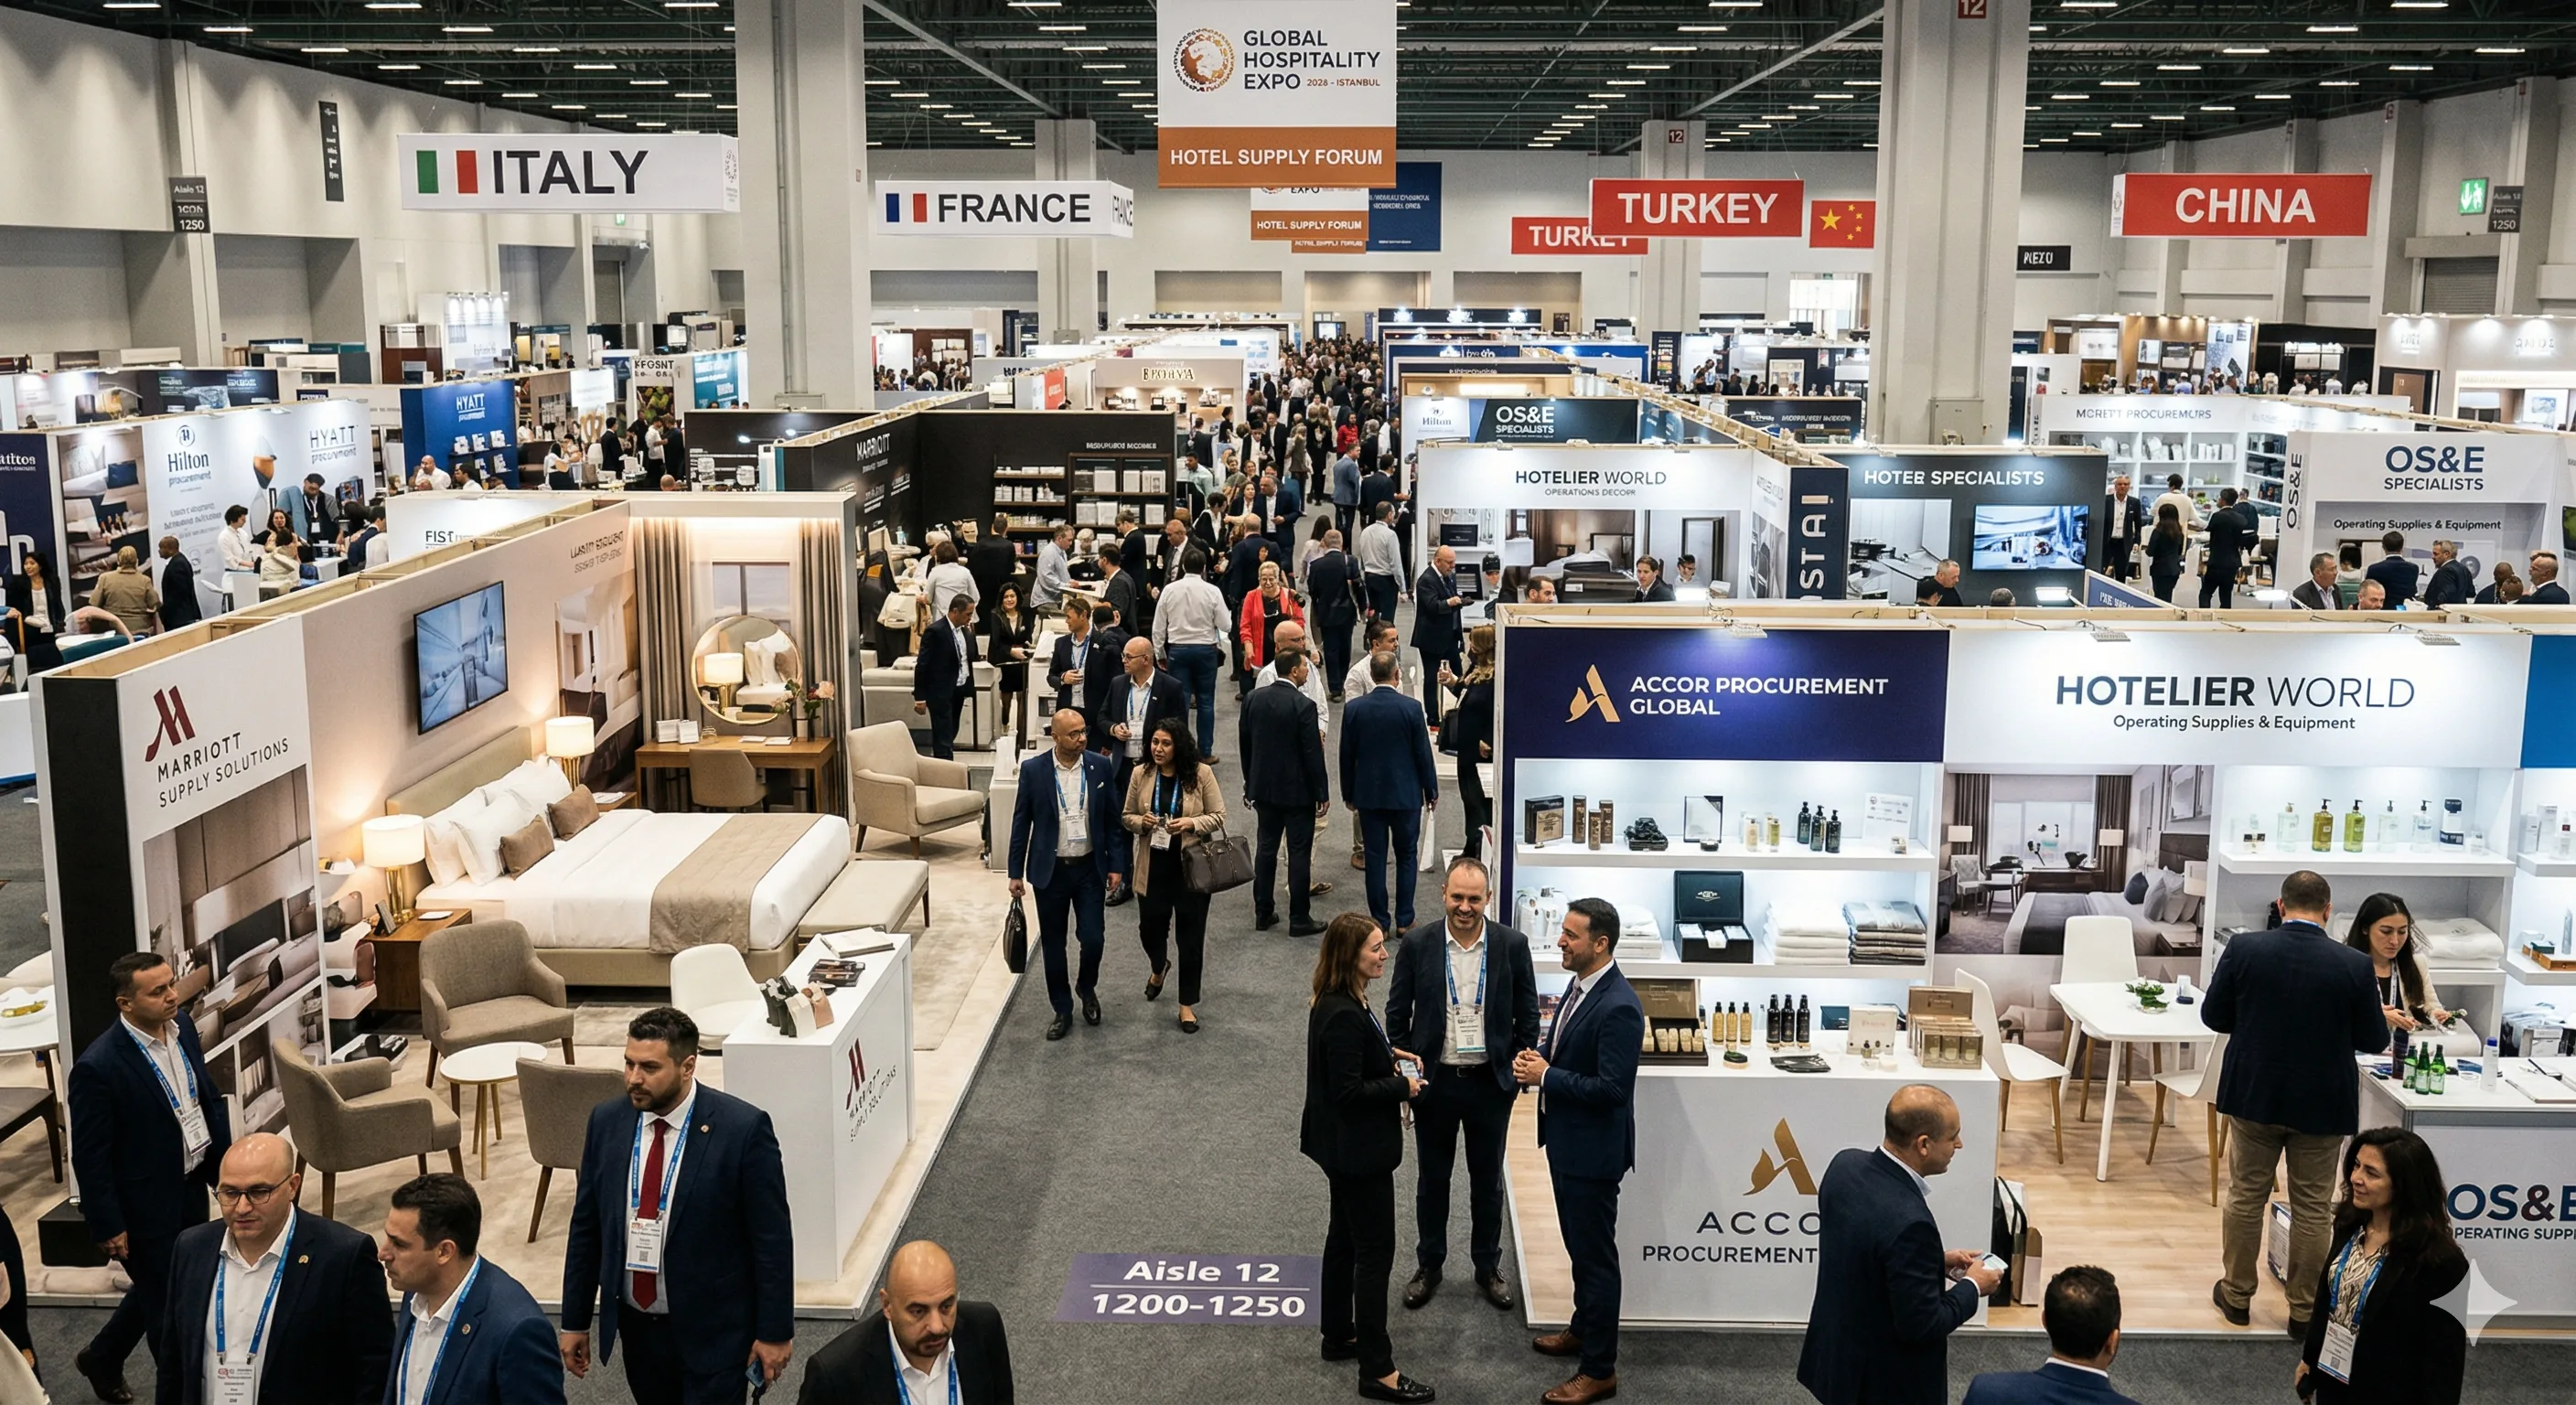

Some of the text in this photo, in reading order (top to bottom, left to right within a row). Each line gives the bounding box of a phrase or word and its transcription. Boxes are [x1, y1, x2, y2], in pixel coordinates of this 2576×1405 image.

[1960, 0, 1984, 16] 12
[1243, 30, 1328, 47] GLOBAL
[1243, 51, 1381, 68] HOSPITALITY
[1243, 73, 1301, 90] EXPO
[1336, 79, 1380, 87] ISTANBUL
[1669, 131, 1683, 143] 12
[1170, 149, 1383, 166] HOTEL SUPPLY FORUM
[492, 150, 649, 195] ITALY
[938, 193, 1091, 222] FRANCE
[1617, 193, 1778, 224] TURKEY
[2174, 188, 2316, 223] CHINA
[179, 220, 205, 231] 1250
[1257, 220, 1362, 230] HOTEL SUPPLY FORUM
[2493, 220, 2517, 230] 1250
[456, 392, 485, 411] HYATT
[1496, 405, 1555, 424] OS&E
[309, 425, 355, 449] HYATT
[167, 450, 209, 473] Hilton
[2385, 445, 2485, 473] OS&E
[1515, 470, 1667, 485] HOTELIER WORLD
[1930, 470, 2045, 486] SPECIALISTS
[2384, 477, 2485, 491] SPECIALISTS
[1544, 488, 1600, 497] OPERATIONS
[2286, 452, 2303, 530] OS&E
[2334, 519, 2502, 531] Operating Supplies & Equipment
[1630, 675, 1889, 695] ACCOR PROCUREMENT
[2055, 675, 2415, 708] HOTELIER WORLD
[1629, 698, 1721, 715] GLOBAL
[2113, 713, 2356, 733] Operating Supplies & Equipment
[157, 732, 242, 782] MARRIOTT
[159, 737, 289, 809] SUPPLY SOLUTIONS
[2447, 1184, 2576, 1222] OS&E
[1696, 1211, 1820, 1235] ACCO
[2454, 1227, 2576, 1240] PERATING SUPP
[1643, 1245, 1818, 1263] PROCUREMENT
[1123, 1260, 1280, 1283] Aisle 12
